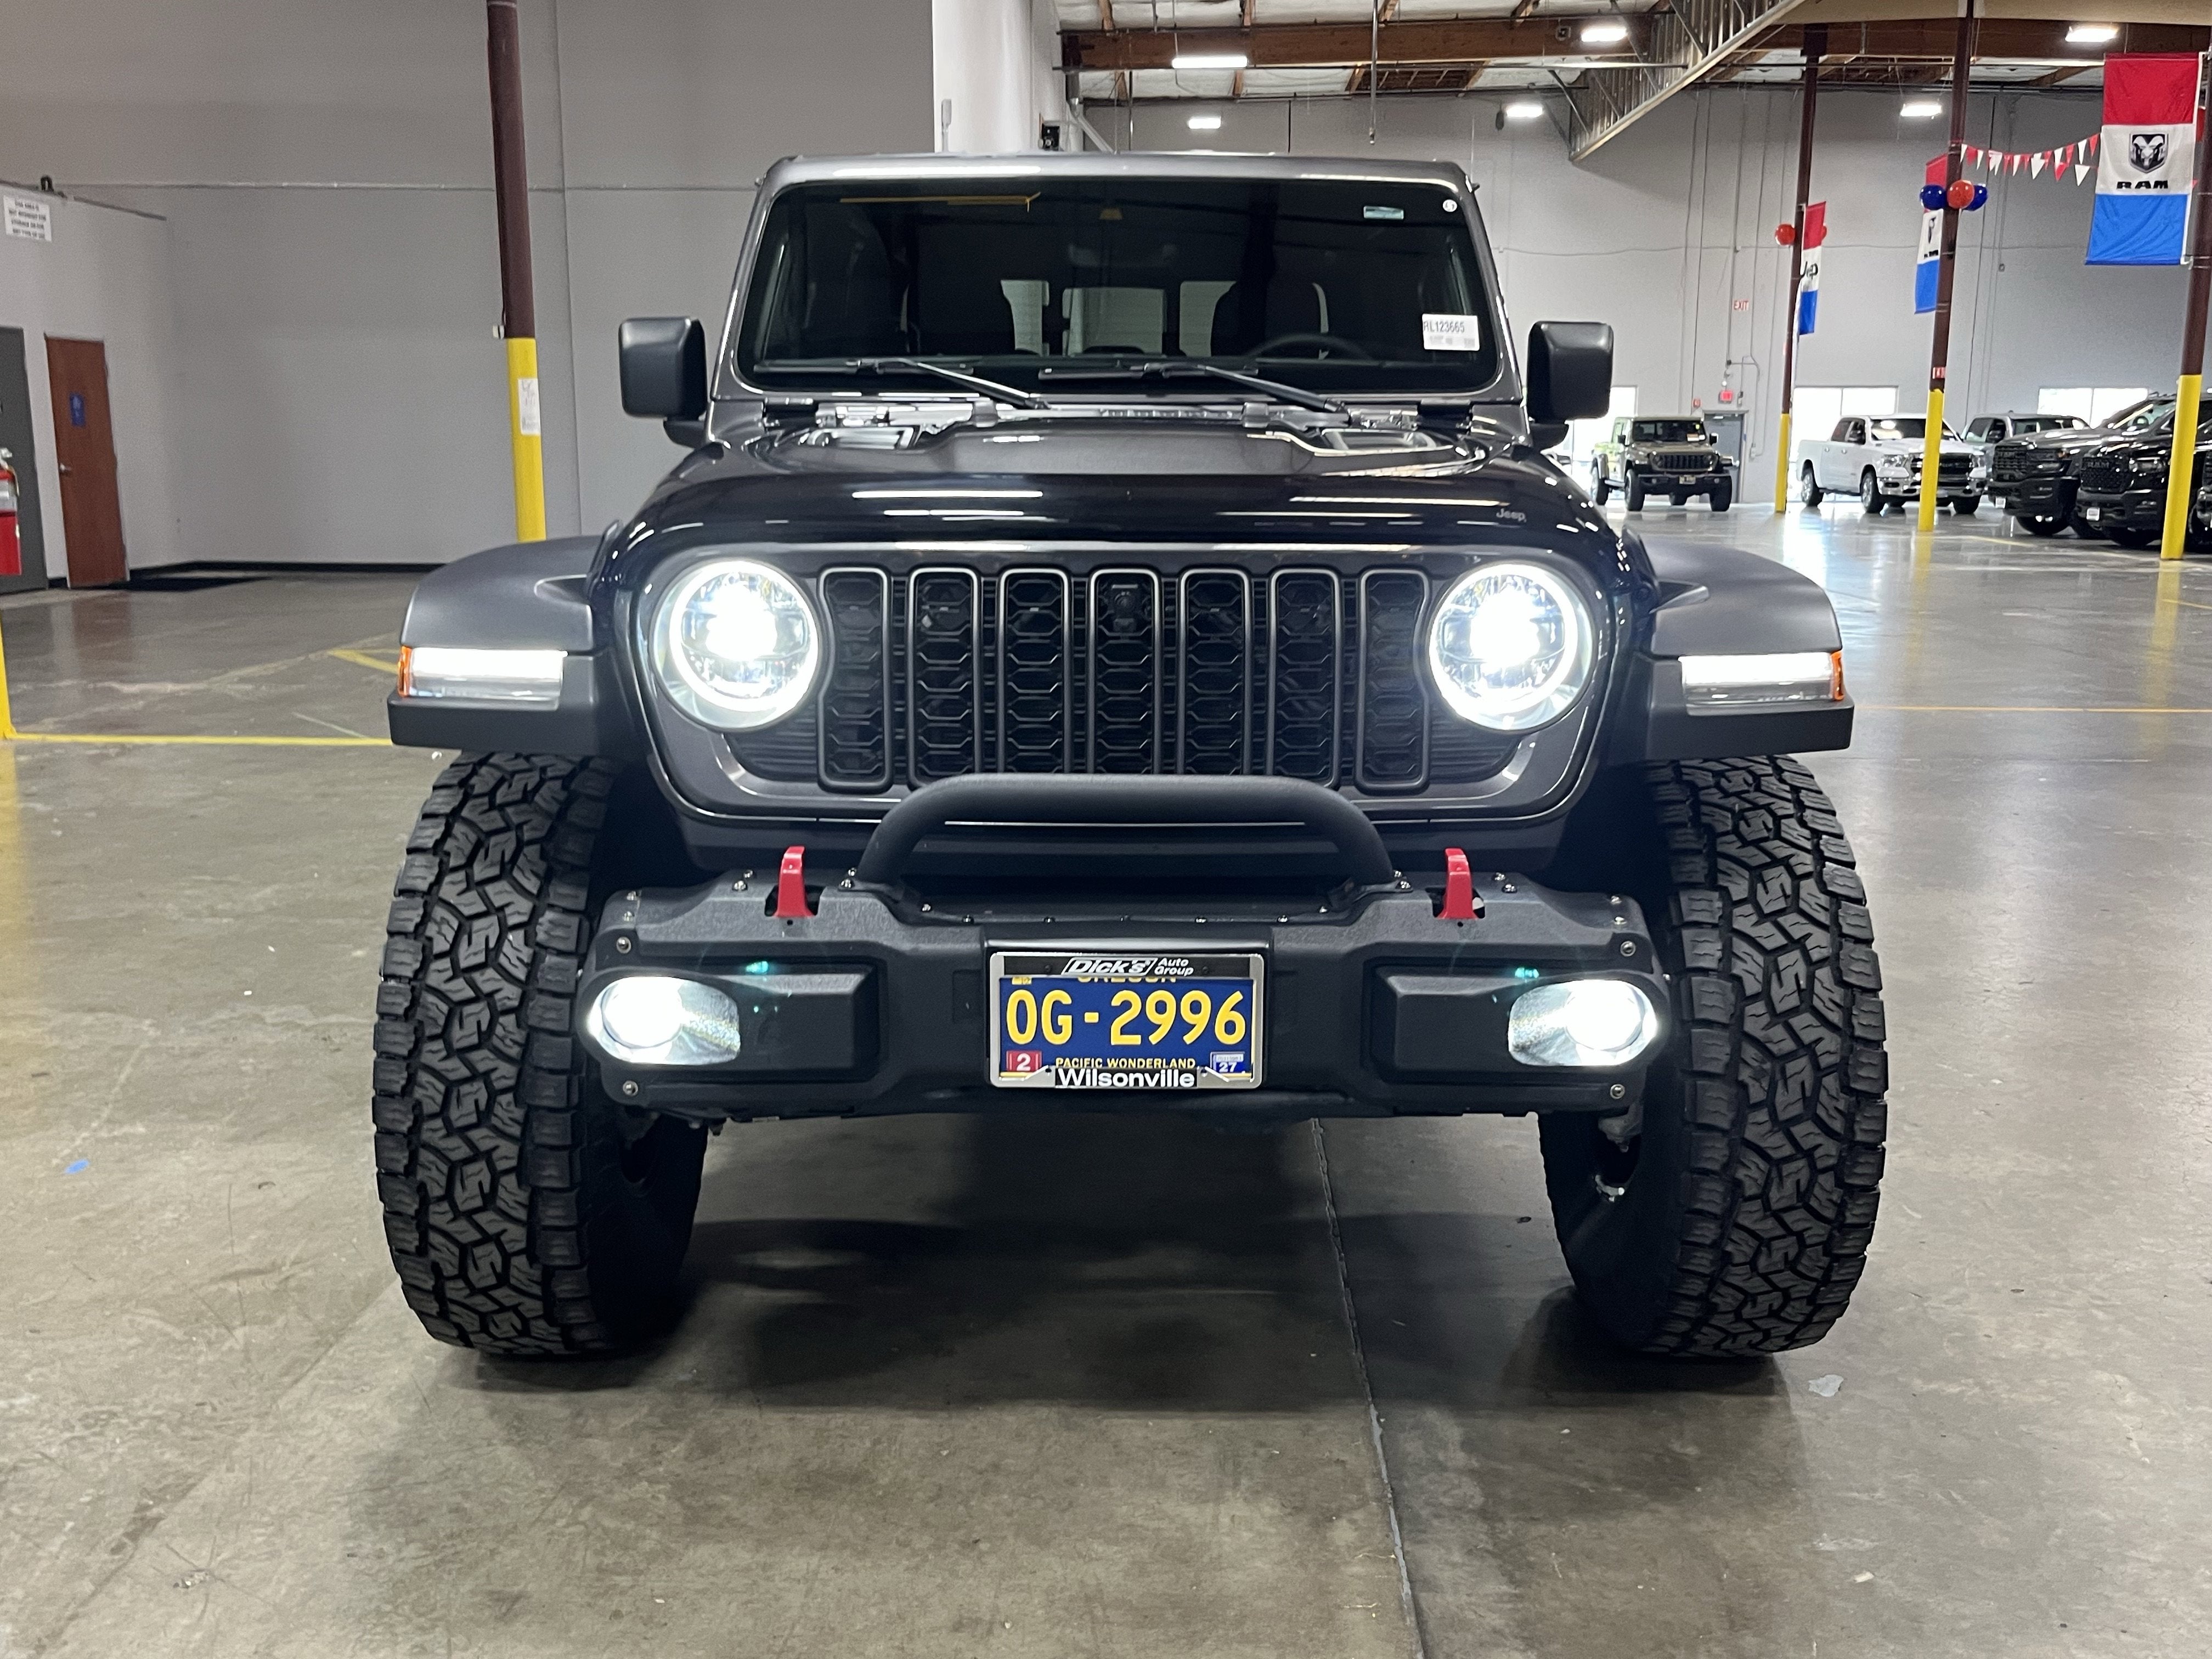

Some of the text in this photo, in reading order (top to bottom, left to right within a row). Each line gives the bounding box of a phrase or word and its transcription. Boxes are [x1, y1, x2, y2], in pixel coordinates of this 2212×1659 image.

[2117, 180, 2168, 189] RAM
[1734, 300, 1748, 311] EXIT
[1496, 508, 1527, 523] Jeep
[1158, 958, 1189, 967] Auto
[1154, 967, 1194, 977] Group
[1017, 1053, 1031, 1071] 2
[1056, 1057, 1196, 1069] PACIFIC WONDERLAND
[1219, 1062, 1237, 1073] 27
[1058, 1068, 1195, 1088] Wilsonville
